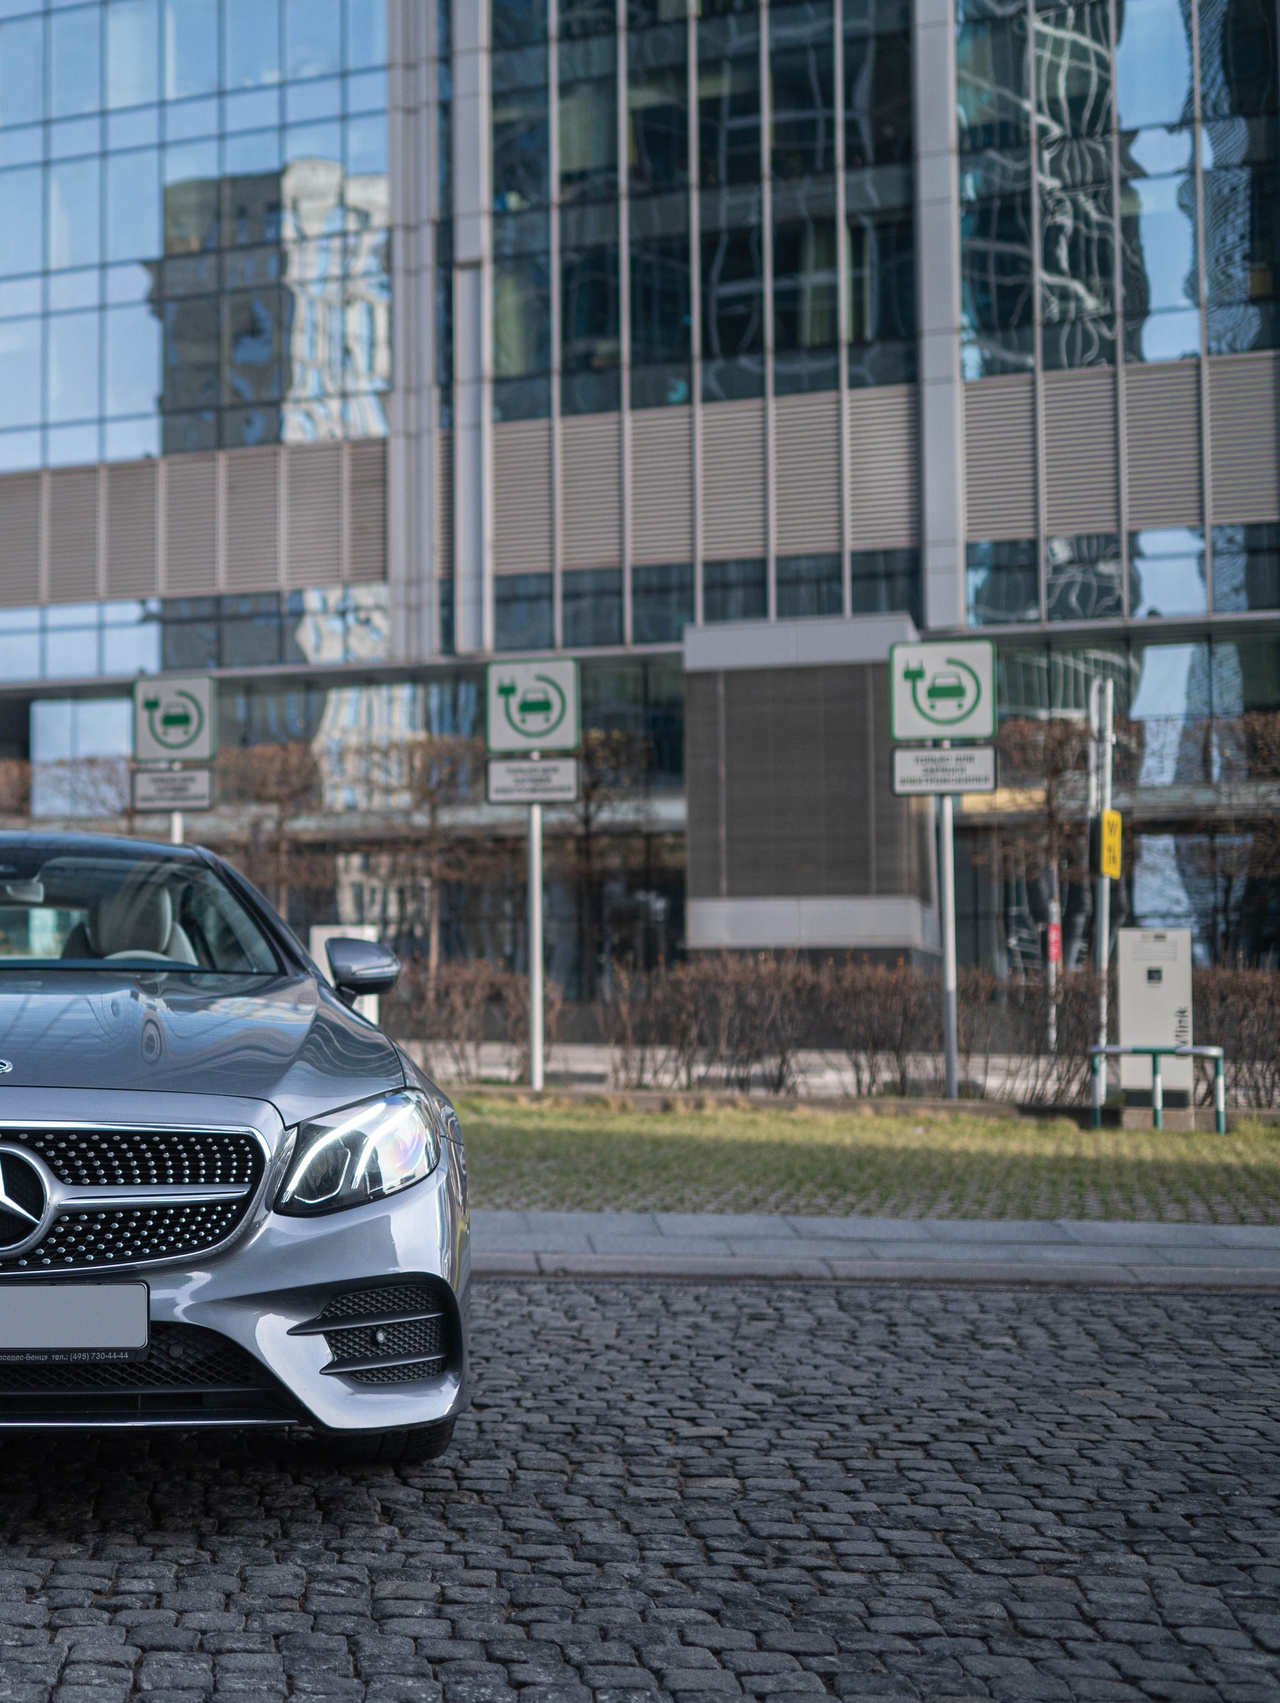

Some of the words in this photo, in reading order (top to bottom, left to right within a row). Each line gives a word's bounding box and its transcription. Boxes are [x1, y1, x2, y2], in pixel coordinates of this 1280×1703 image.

[1174, 1005, 1189, 1056] Vlink
[69, 1352, 90, 1361] (495)
[91, 1351, 129, 1360] 730-44-44
